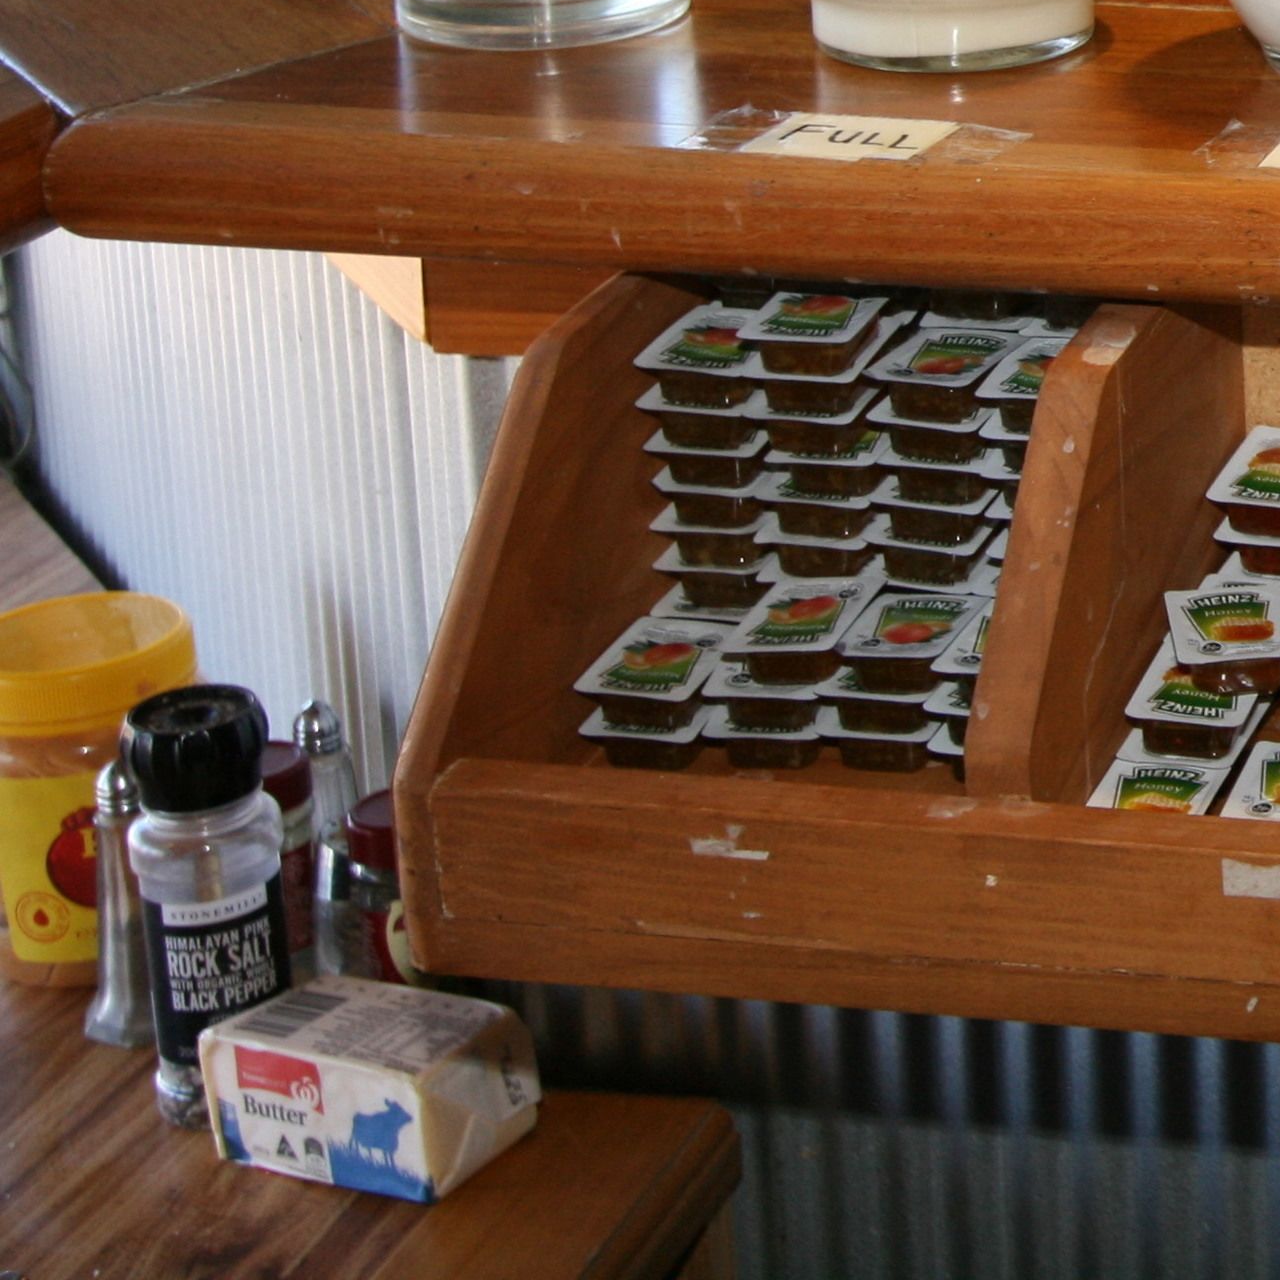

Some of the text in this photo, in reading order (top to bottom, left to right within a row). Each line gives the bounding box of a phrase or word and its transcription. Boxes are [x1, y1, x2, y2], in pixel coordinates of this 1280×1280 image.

[778, 123, 919, 150] FULL
[1197, 594, 1252, 606] HEINZ
[1204, 608, 1252, 618] Honey
[1172, 688, 1220, 702] Honey
[1161, 701, 1217, 717] HEINZ
[1138, 769, 1195, 780] HEINZ
[1134, 782, 1181, 793] Honey
[165, 915, 271, 951] HIMALAYAN PINK
[167, 932, 272, 978] ROCK SALT
[171, 978, 194, 991] WITH
[172, 971, 277, 1012] BLACK PEPPER
[243, 1092, 308, 1126] Butter
